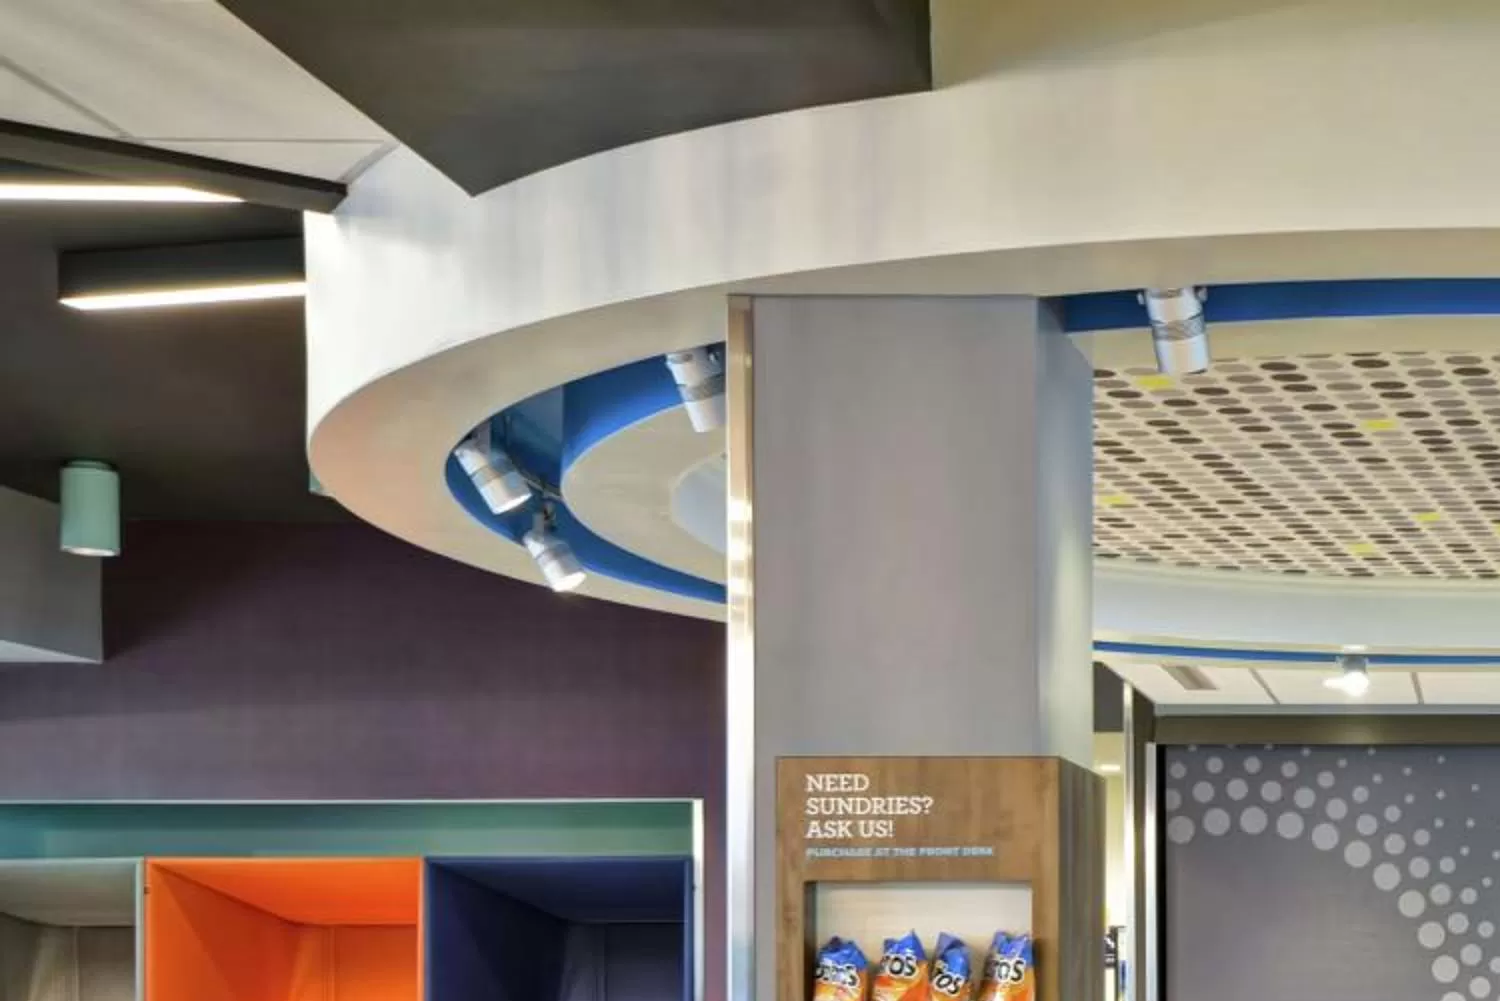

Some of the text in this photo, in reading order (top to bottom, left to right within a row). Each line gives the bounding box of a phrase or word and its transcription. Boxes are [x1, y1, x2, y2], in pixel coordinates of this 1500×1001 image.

[805, 773, 870, 792] NEED
[805, 796, 934, 815] SUNDRIES?
[805, 819, 894, 839] ASK US!
